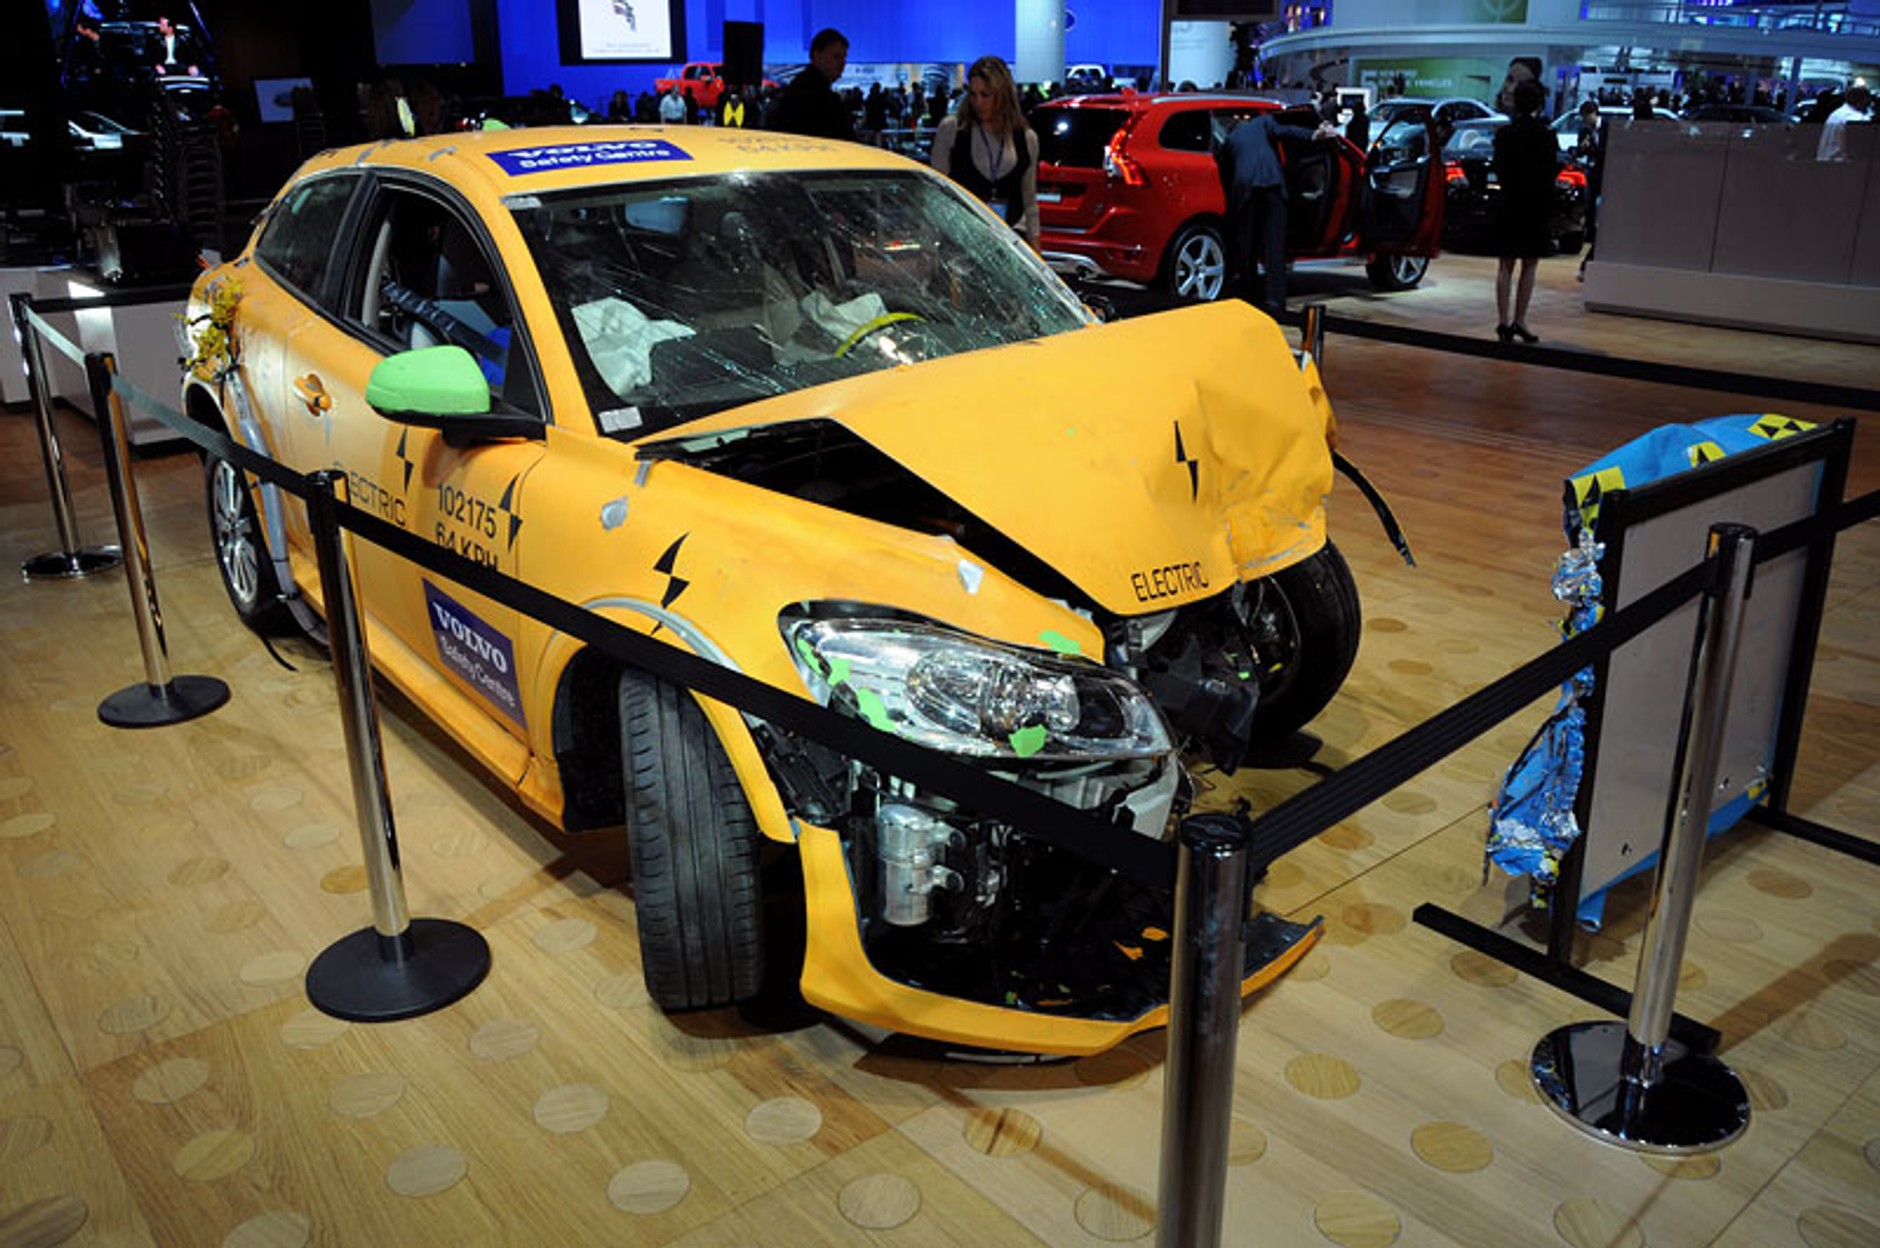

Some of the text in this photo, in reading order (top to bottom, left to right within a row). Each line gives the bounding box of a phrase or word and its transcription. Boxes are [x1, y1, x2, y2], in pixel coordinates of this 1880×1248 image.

[507, 142, 657, 158] VOLVO
[519, 149, 670, 168] Safety Centre
[346, 468, 405, 526] ECTRIC
[437, 483, 497, 539] 102175
[1131, 561, 1209, 601] ELECTRIC
[432, 601, 508, 673] VOLVO
[440, 635, 516, 707] Safety Centre
